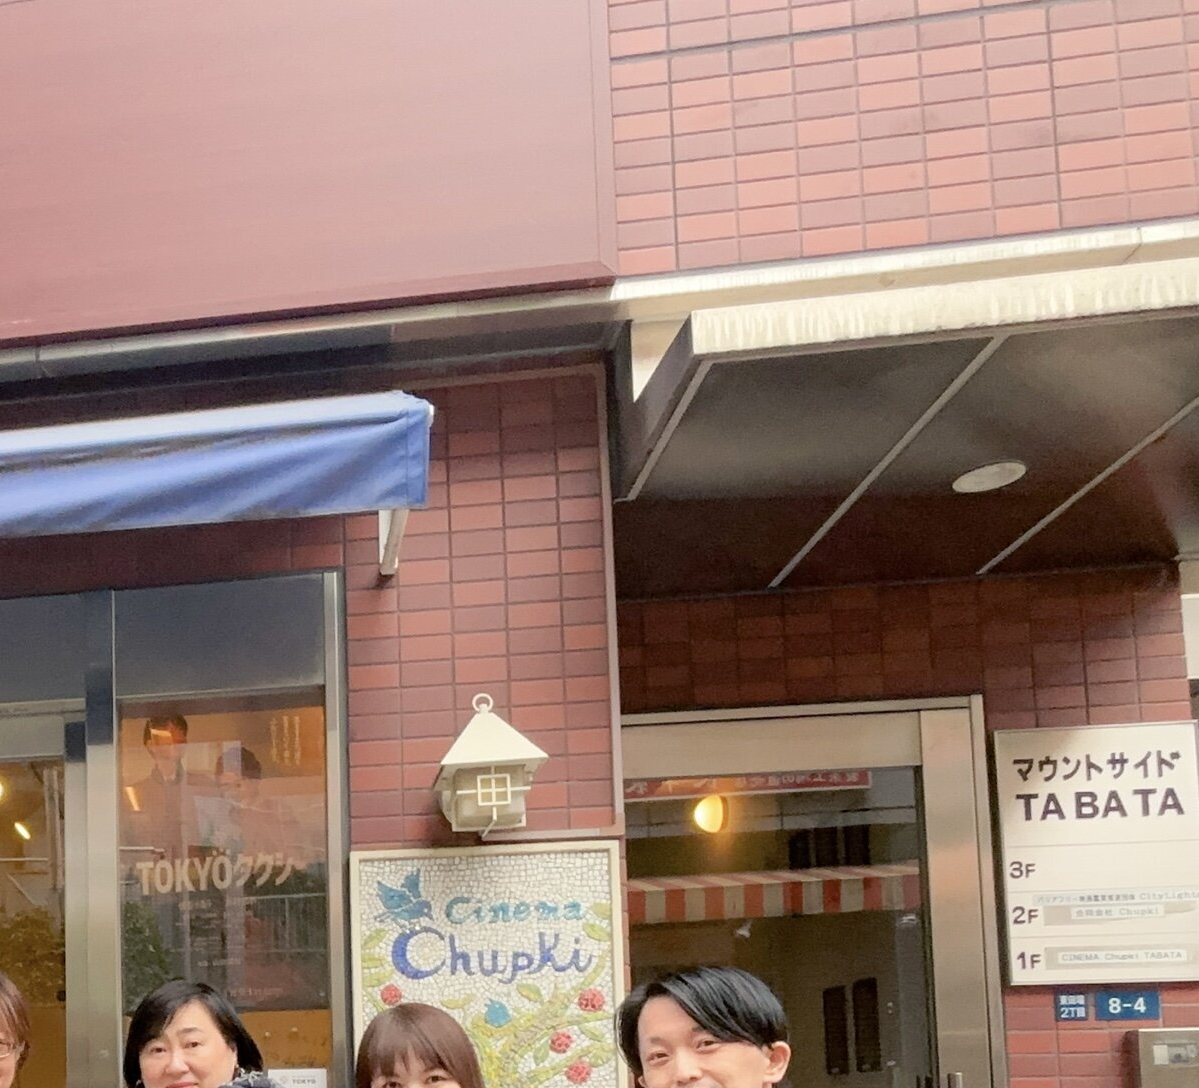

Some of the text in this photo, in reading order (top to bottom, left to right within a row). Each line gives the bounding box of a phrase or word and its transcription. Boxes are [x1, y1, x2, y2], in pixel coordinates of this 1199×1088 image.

[1012, 750, 1180, 782] マウントサイド
[1015, 787, 1185, 821] TABATA
[1009, 861, 1036, 879] 3F
[446, 896, 587, 925] Cinema
[1012, 907, 1039, 925] 2F
[1016, 952, 1042, 970] 1F
[1061, 953, 1099, 962] CINEMA
[1144, 951, 1182, 960] TABATA
[1108, 996, 1146, 1014] 8-4
